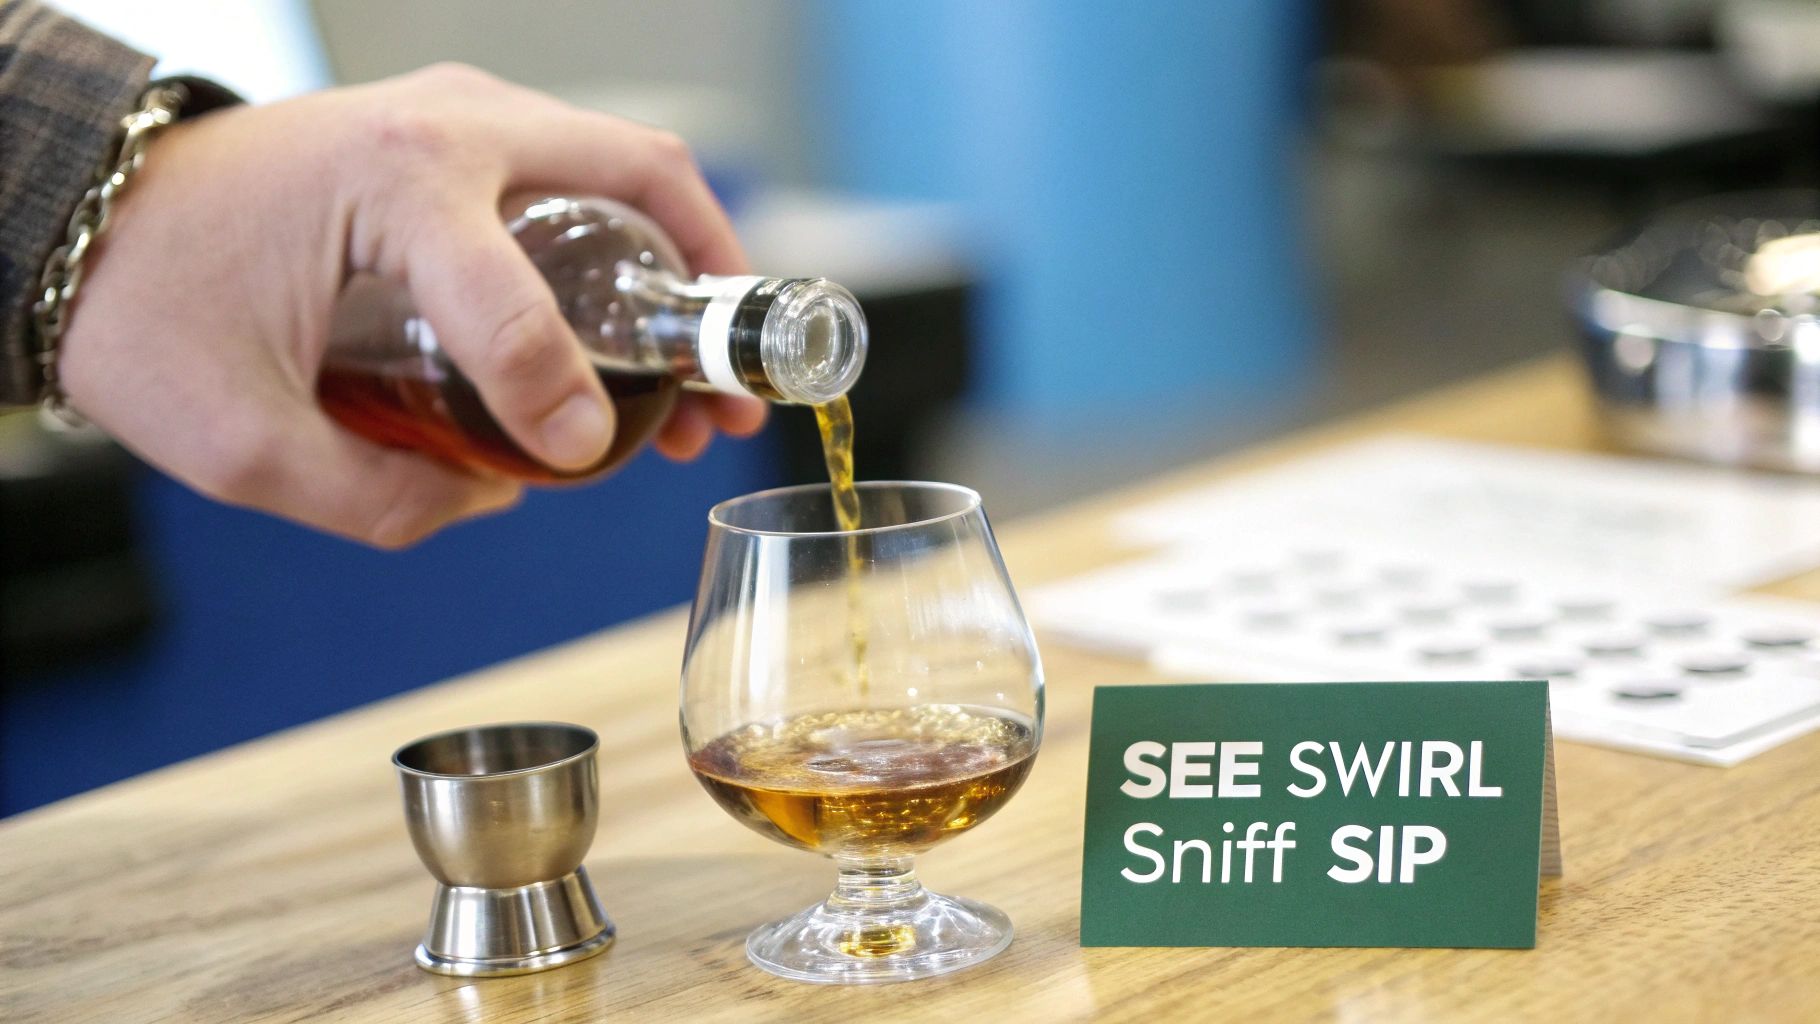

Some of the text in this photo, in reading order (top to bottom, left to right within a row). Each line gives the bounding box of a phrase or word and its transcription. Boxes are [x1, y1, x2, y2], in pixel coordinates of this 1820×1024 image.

[1119, 740, 1503, 799] SEE SWIRL
[1120, 821, 1447, 884] Sniff SIP
